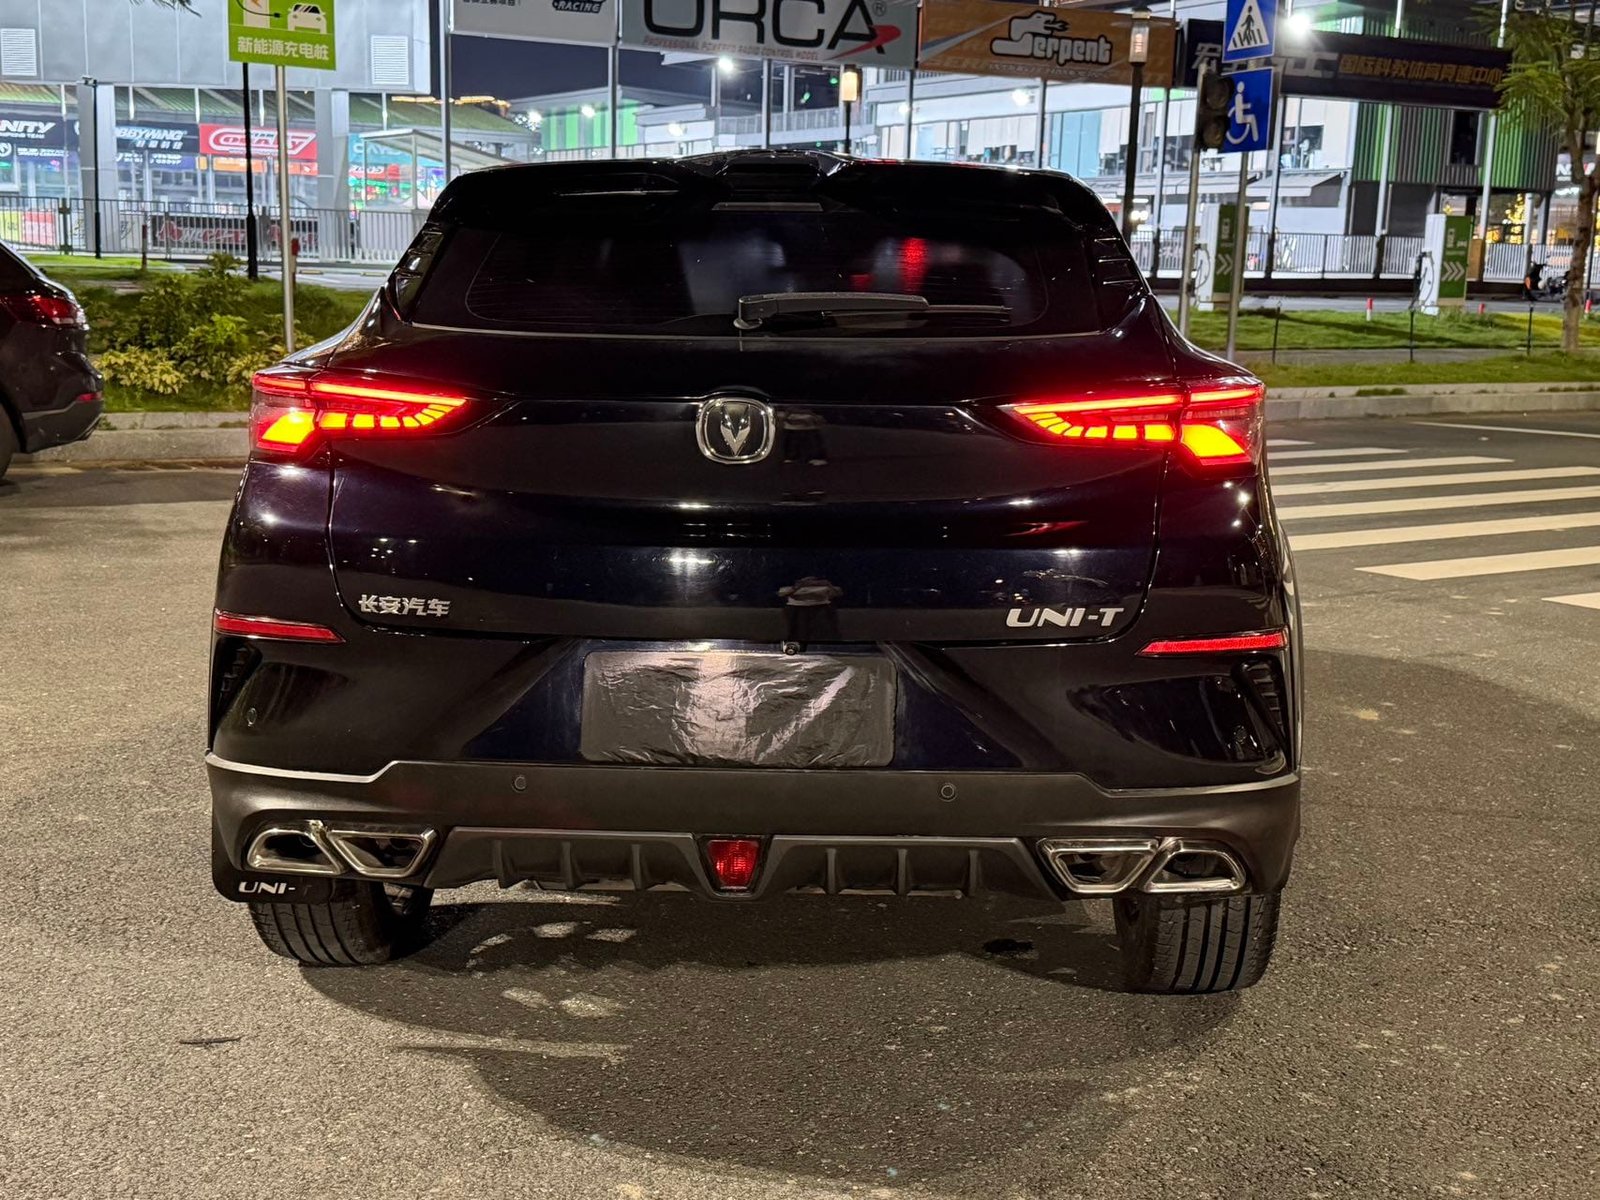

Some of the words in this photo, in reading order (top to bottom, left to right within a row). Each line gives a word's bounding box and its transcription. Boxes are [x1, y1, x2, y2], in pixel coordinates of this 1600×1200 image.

[557, 1, 600, 13] RACING
[237, 36, 329, 60] 新能源充电桩
[990, 11, 1113, 66] Serpent
[358, 594, 451, 617] 长安汽车
[1006, 607, 1124, 628] UNI-T
